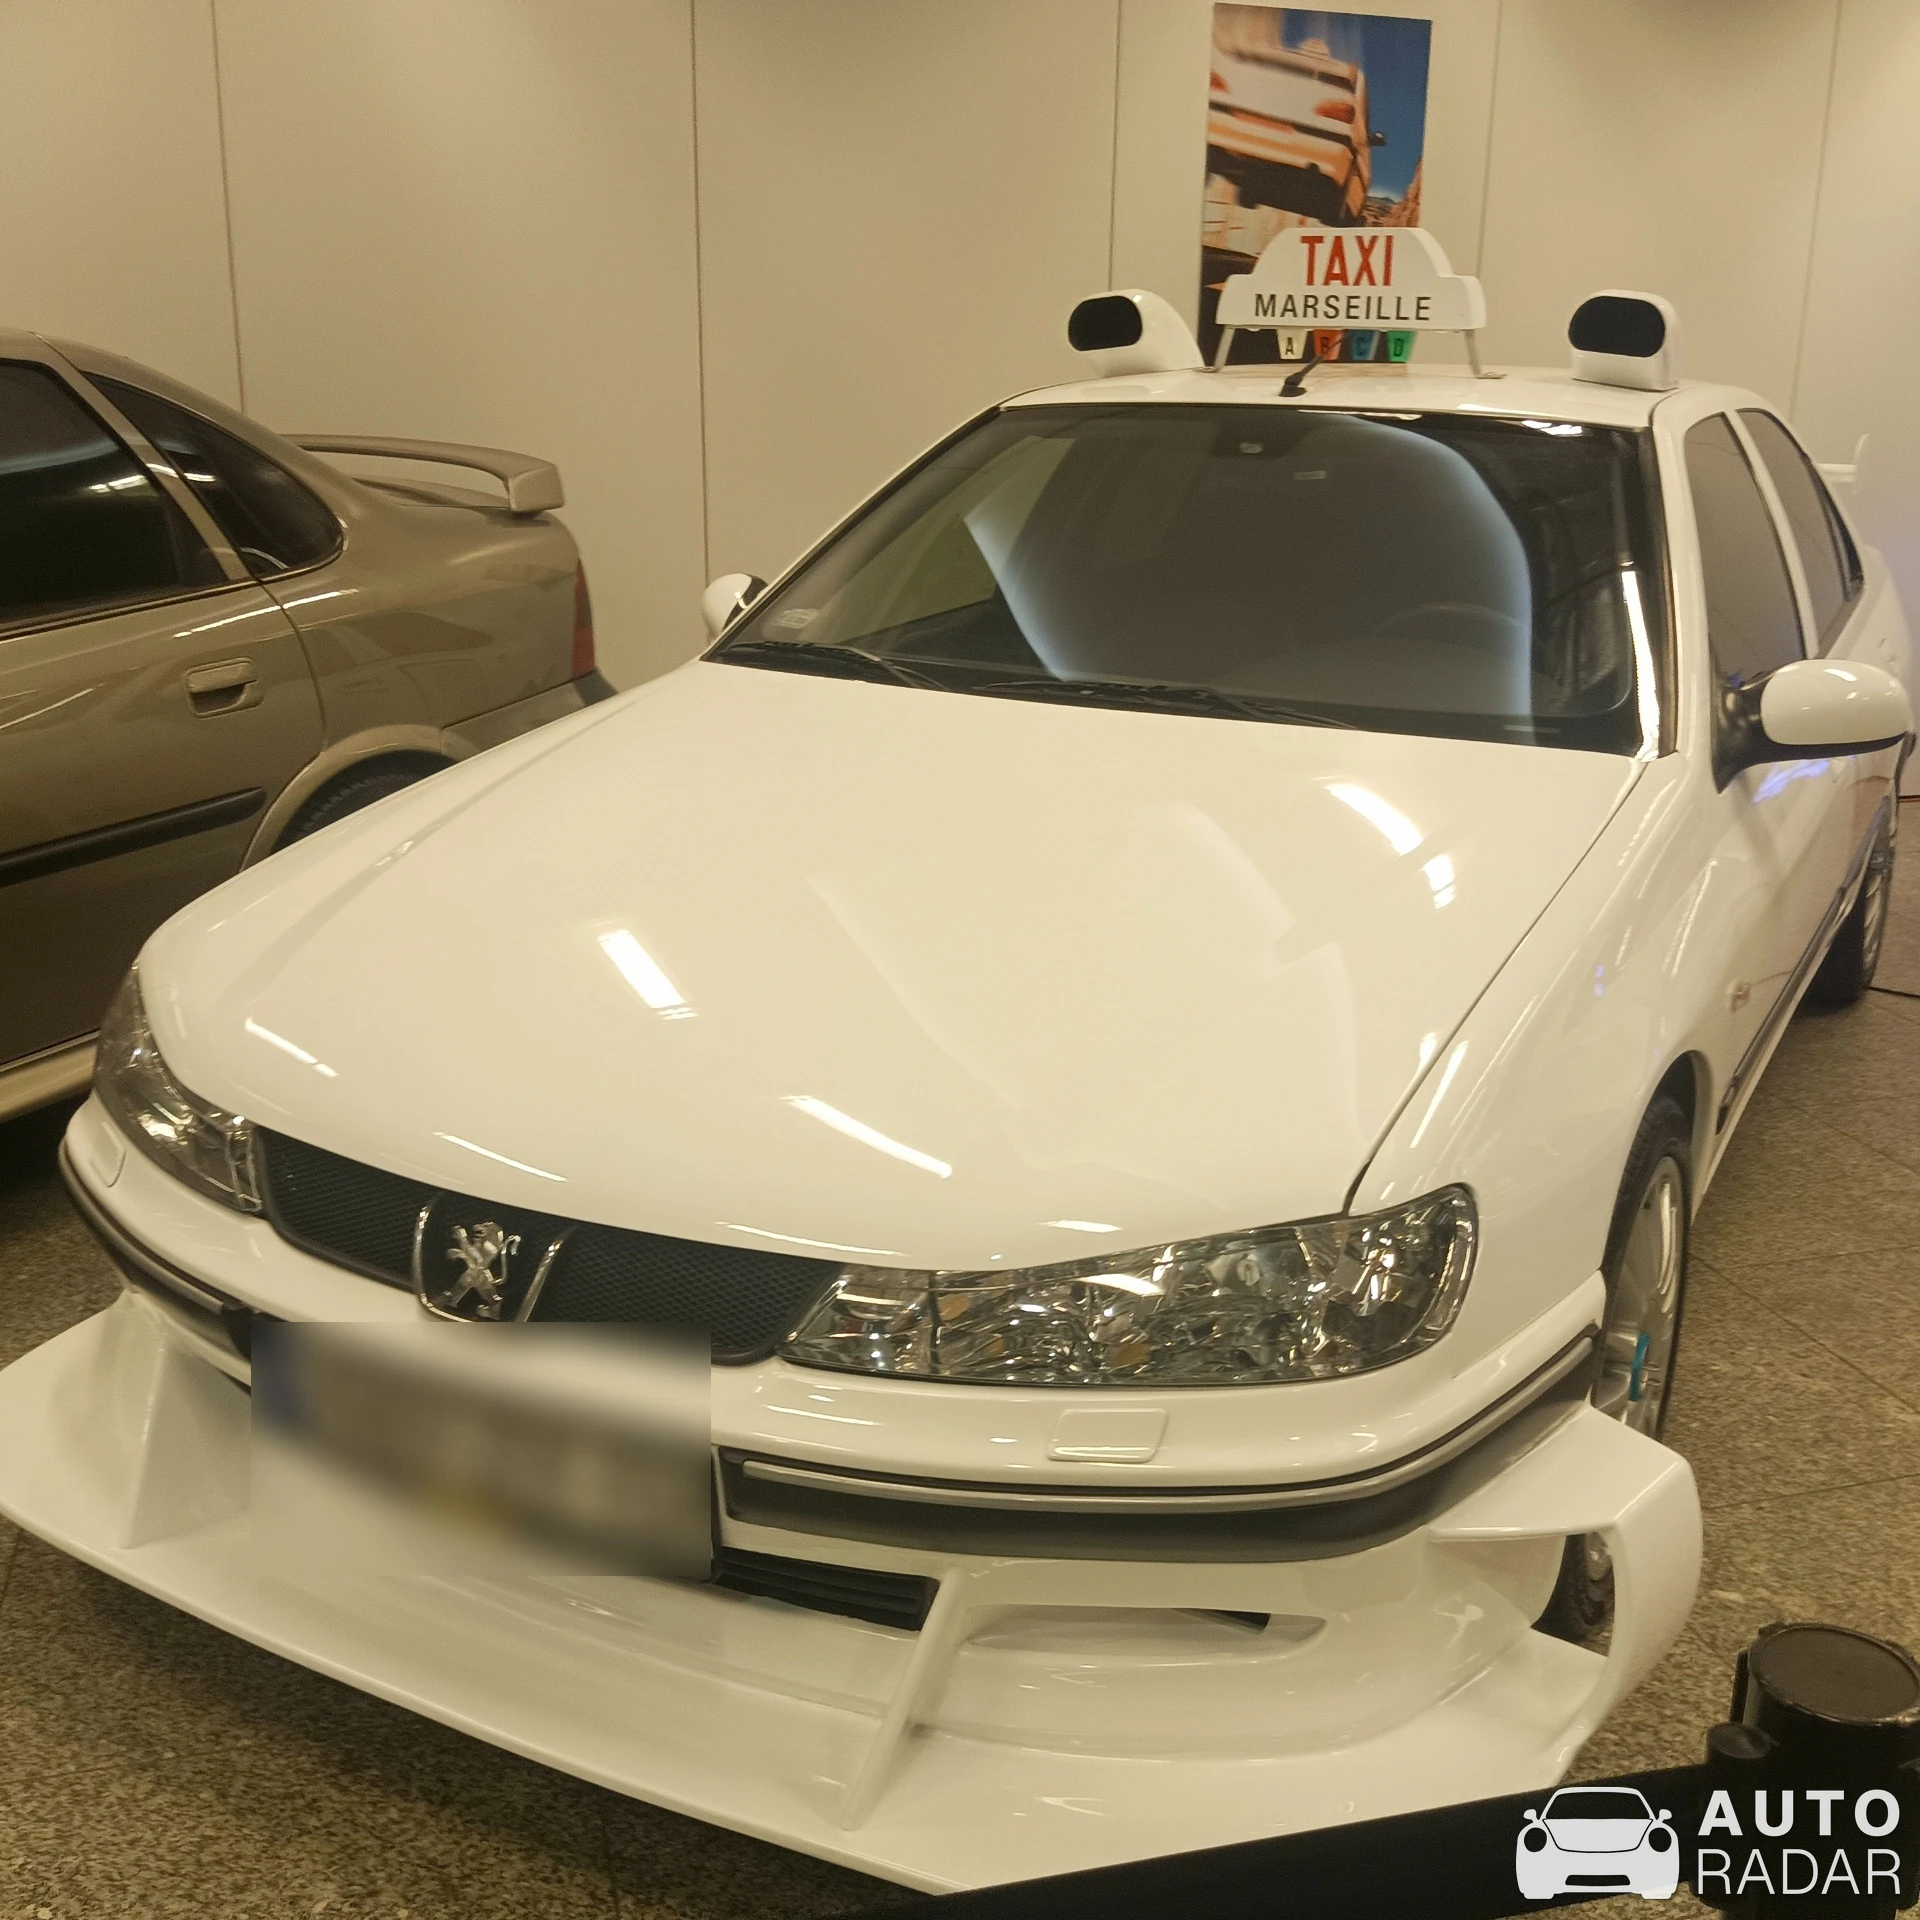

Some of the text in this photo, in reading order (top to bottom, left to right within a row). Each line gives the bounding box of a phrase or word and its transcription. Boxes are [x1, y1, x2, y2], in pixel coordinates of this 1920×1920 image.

[1300, 235, 1394, 286] TAXI
[1255, 293, 1432, 321] MARSEILLE
[1285, 336, 1295, 355] A
[1393, 337, 1405, 357] D
